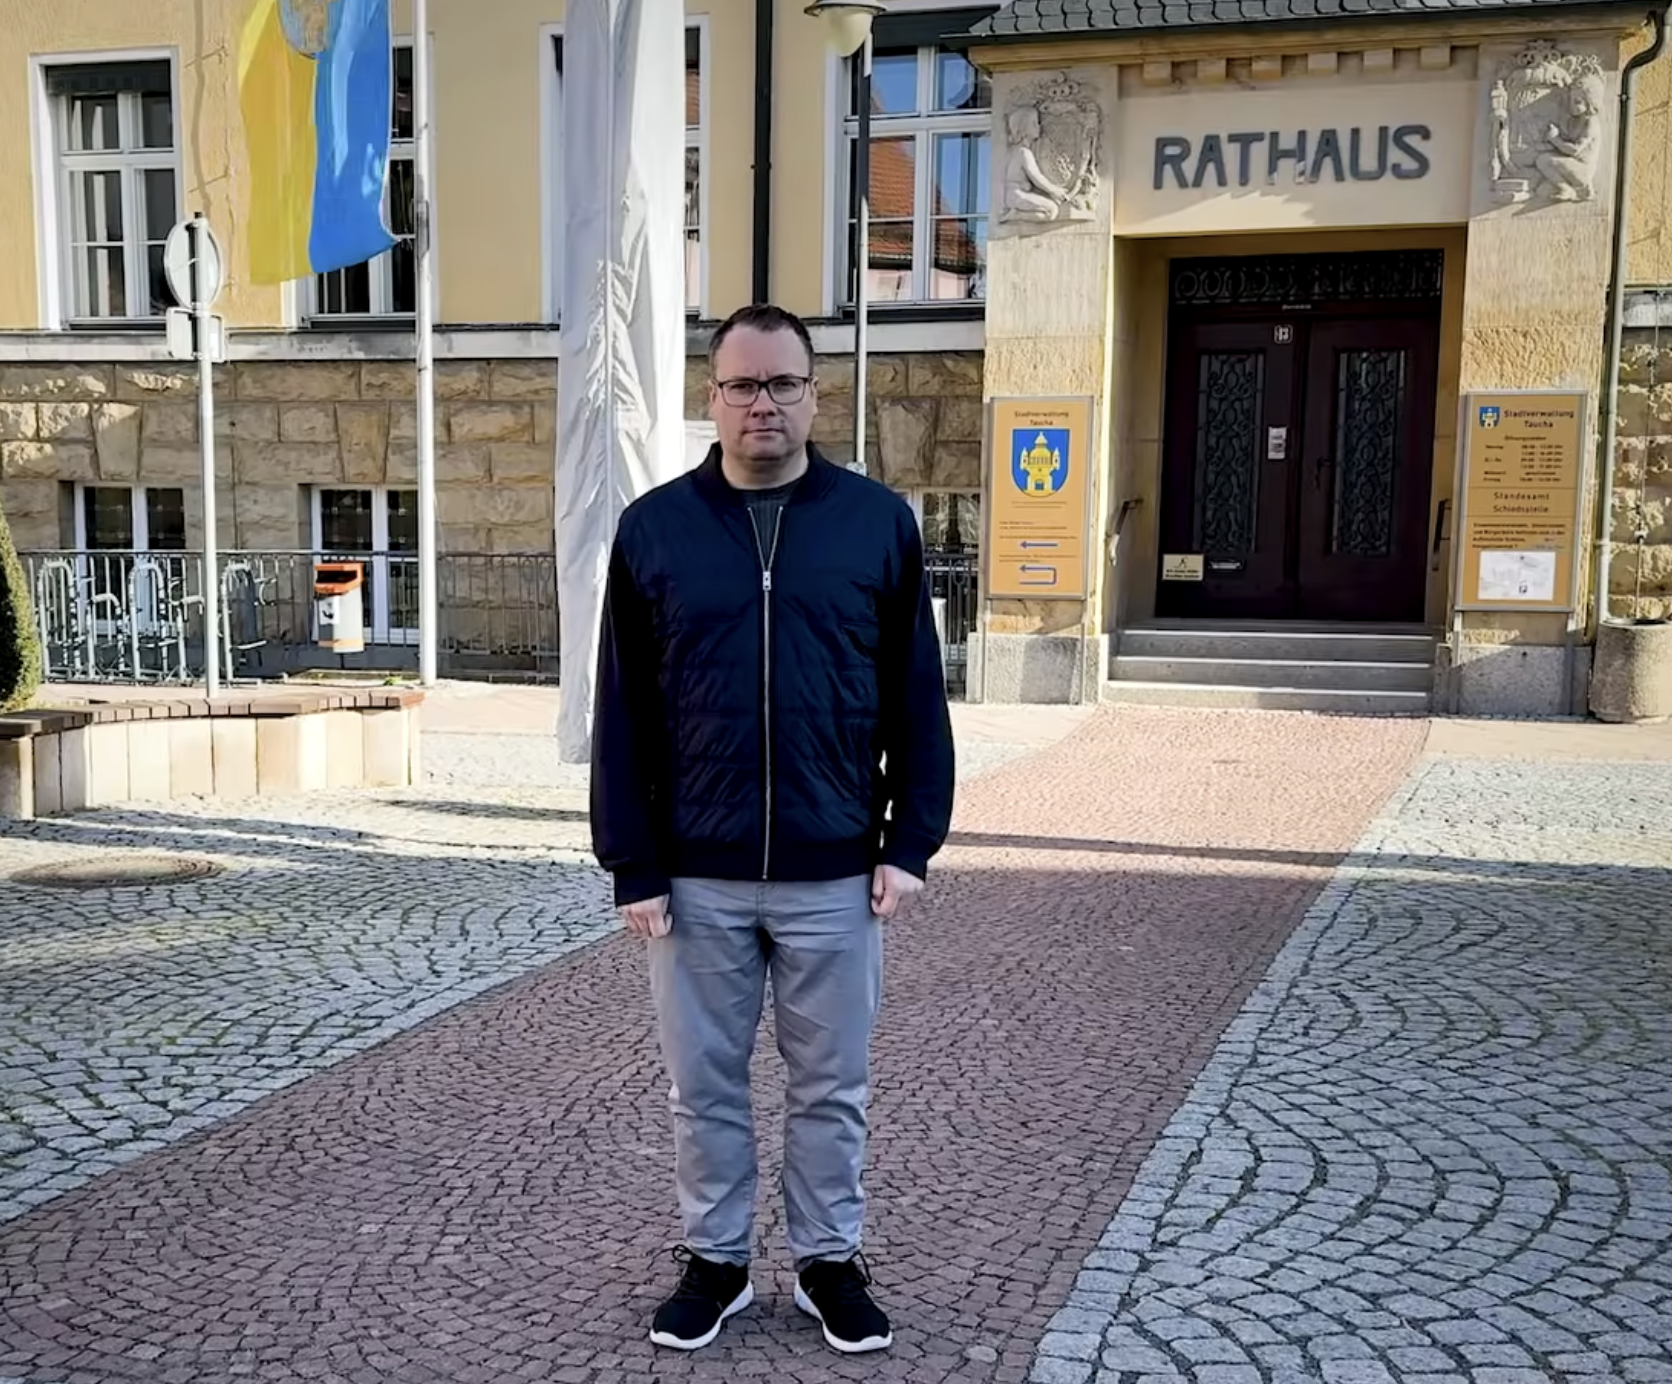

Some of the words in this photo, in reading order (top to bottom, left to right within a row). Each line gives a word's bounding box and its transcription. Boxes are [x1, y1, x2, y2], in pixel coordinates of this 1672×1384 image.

[1153, 124, 1432, 190] RATHAUS
[1503, 410, 1574, 419] Stadtverwaltung
[1524, 420, 1554, 428] Taucha
[1493, 492, 1550, 500] Standesamt
